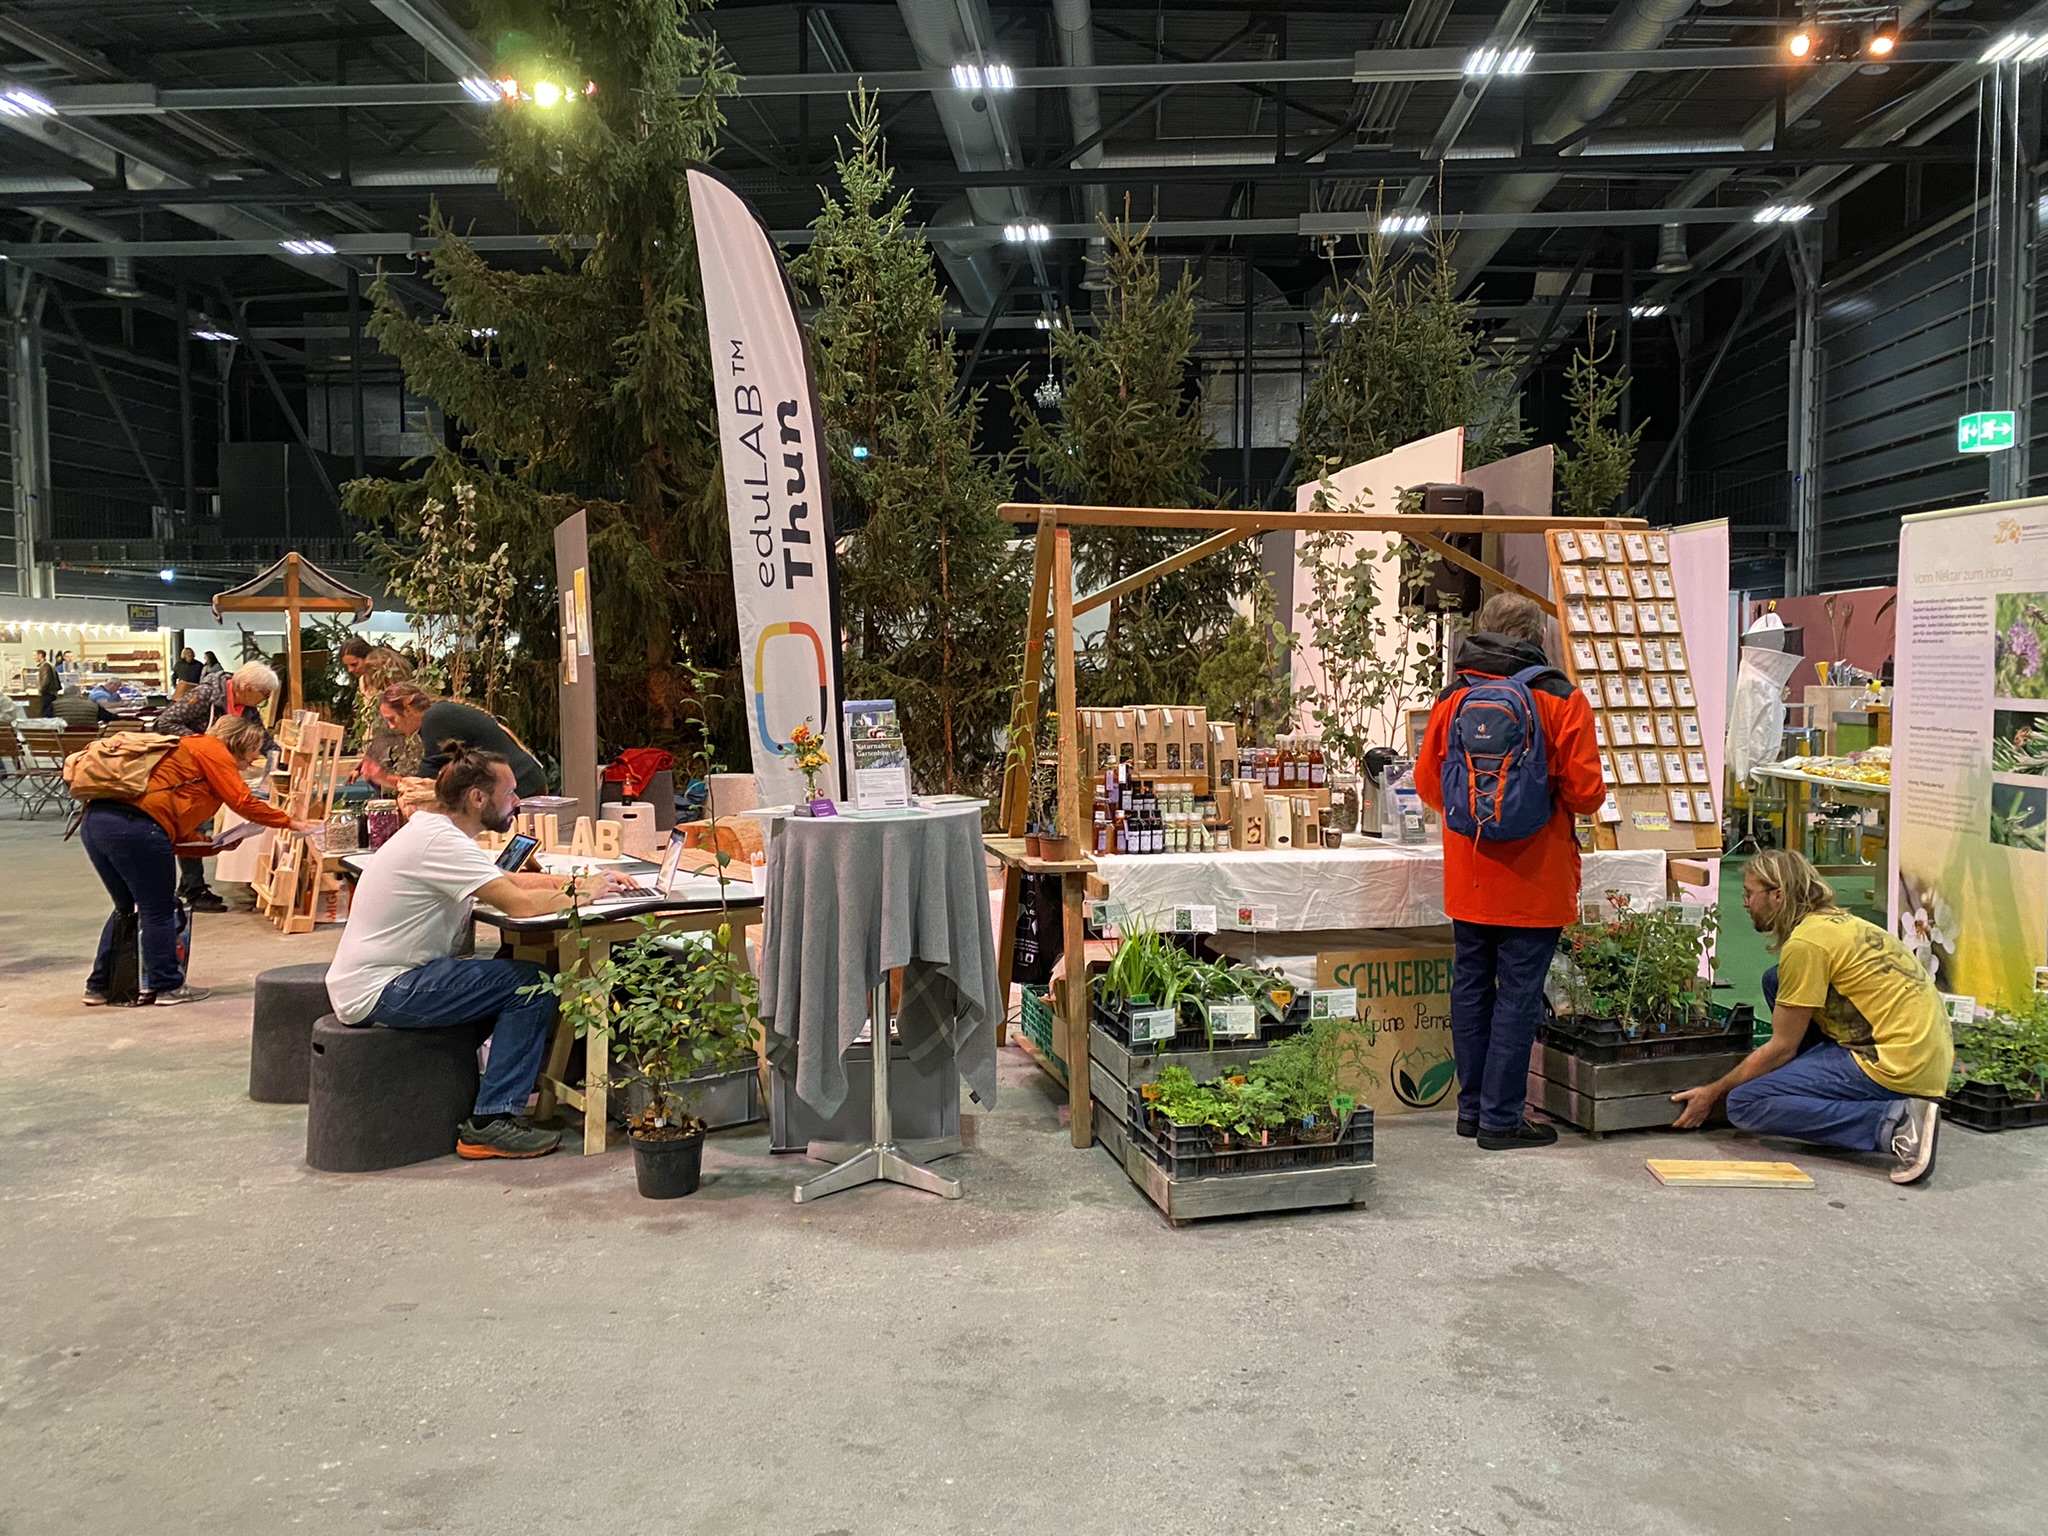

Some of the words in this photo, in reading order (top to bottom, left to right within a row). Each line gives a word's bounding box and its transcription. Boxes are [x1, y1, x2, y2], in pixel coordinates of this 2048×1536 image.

[777, 399, 814, 590] Thun
[1914, 572, 1933, 584] Vom
[1935, 570, 1961, 582] Nektar
[1963, 569, 1983, 581] zum
[1985, 566, 2013, 580] Honig
[1350, 1005, 1405, 1047] Alpine
